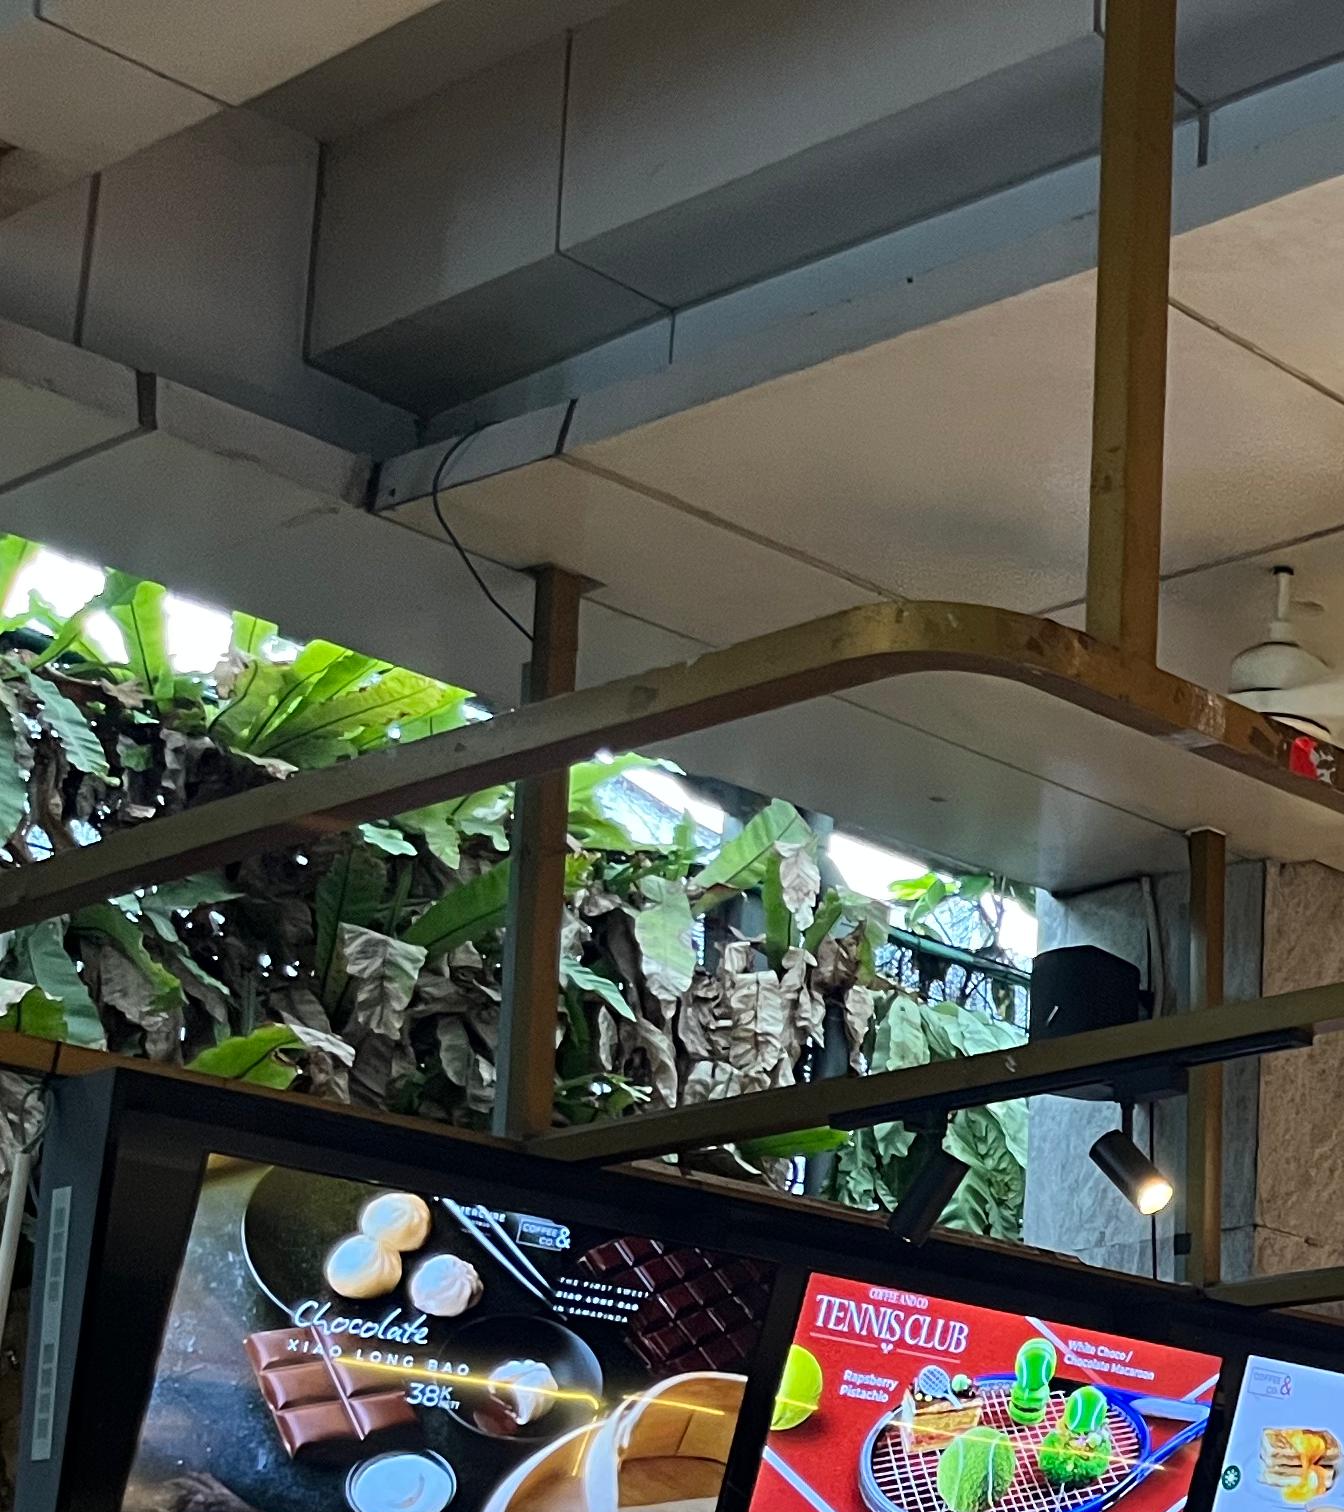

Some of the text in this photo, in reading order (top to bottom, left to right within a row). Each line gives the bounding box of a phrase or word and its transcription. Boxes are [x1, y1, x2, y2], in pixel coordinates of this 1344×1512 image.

[522, 1222, 571, 1249] COFFEE &
[585, 1295, 614, 1307] LONG
[617, 1301, 640, 1312] BAO
[869, 1287, 899, 1304] COFFEE
[899, 1294, 915, 1307] AND
[294, 1300, 429, 1345] Chocolate
[569, 1306, 629, 1323] SAMARINDA
[815, 1294, 970, 1355] TENNIS CLUB
[287, 1338, 471, 1377] XIAO LONG BAO
[1068, 1339, 1096, 1355] White
[1097, 1346, 1126, 1361] Choco
[1064, 1353, 1110, 1372] Chocolate
[839, 1384, 889, 1403] Pistachio
[1280, 1375, 1292, 1396] &
